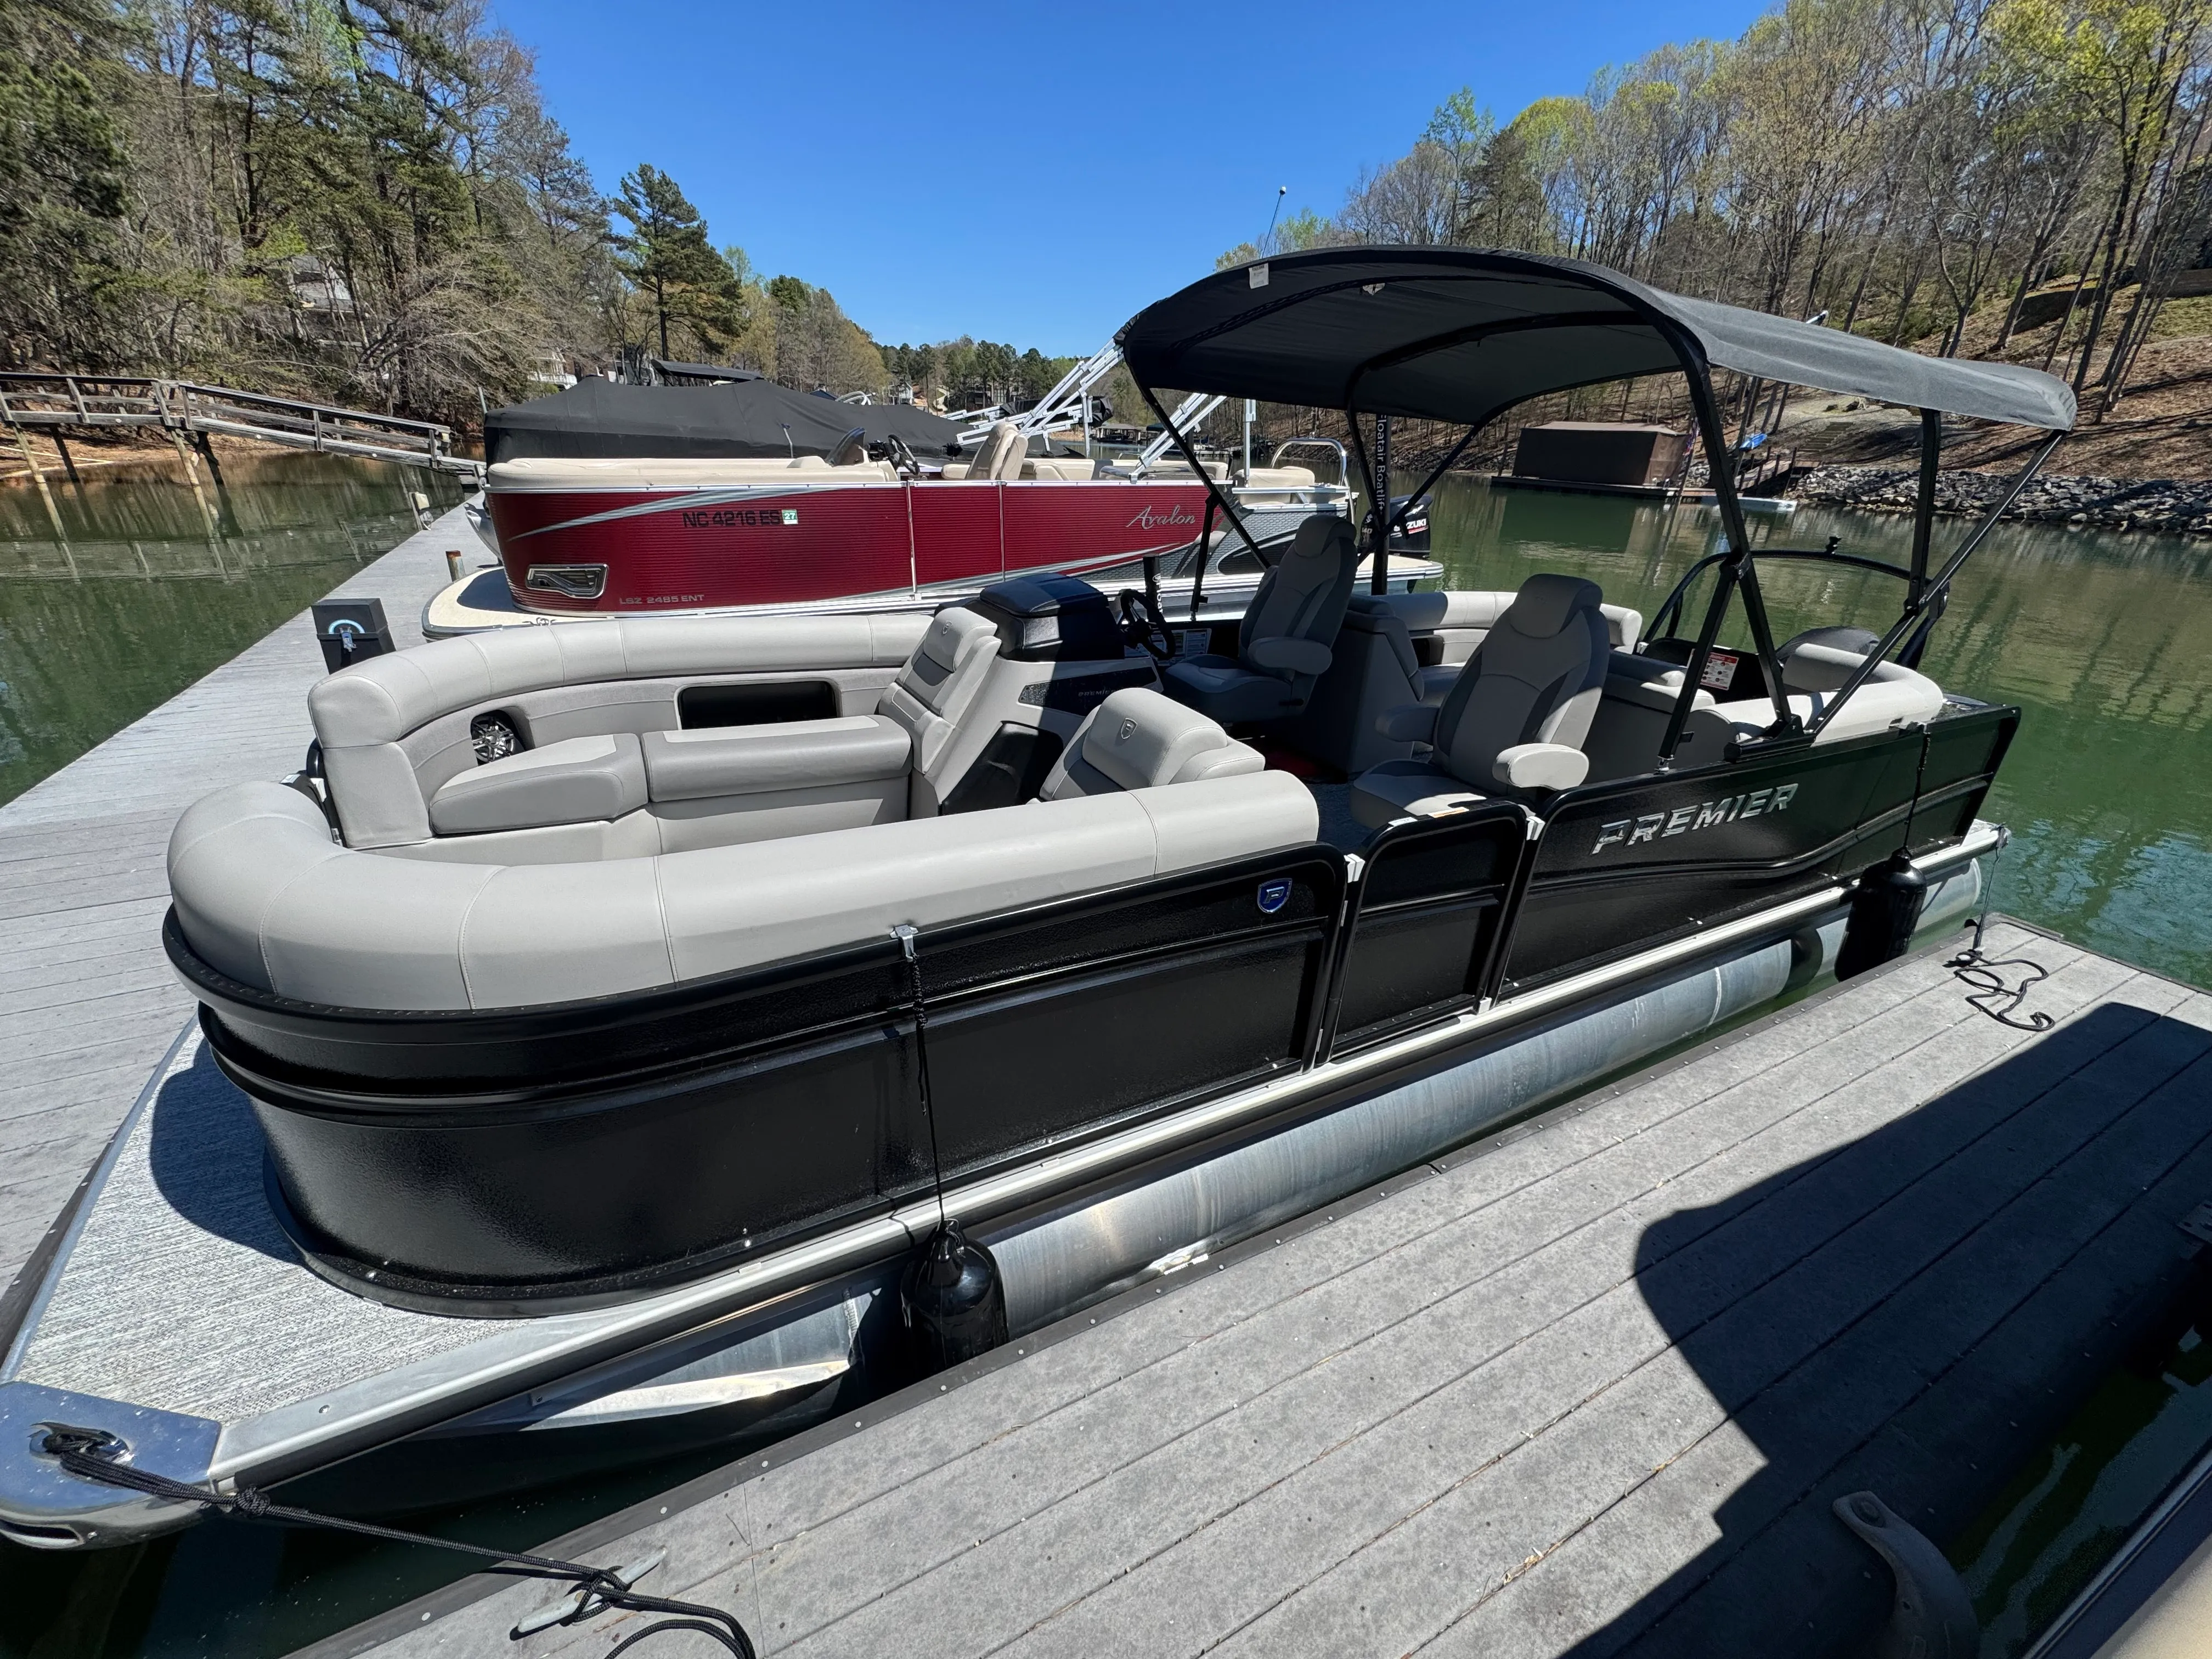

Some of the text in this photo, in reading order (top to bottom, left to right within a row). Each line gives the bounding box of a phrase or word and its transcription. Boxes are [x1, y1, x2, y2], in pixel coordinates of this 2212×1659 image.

[1376, 415, 1387, 461] loatair
[682, 510, 781, 527] NC 4216 ES
[1125, 504, 1195, 530] Avalon
[647, 595, 679, 603] 2485
[1590, 783, 1799, 855] PREMIER
